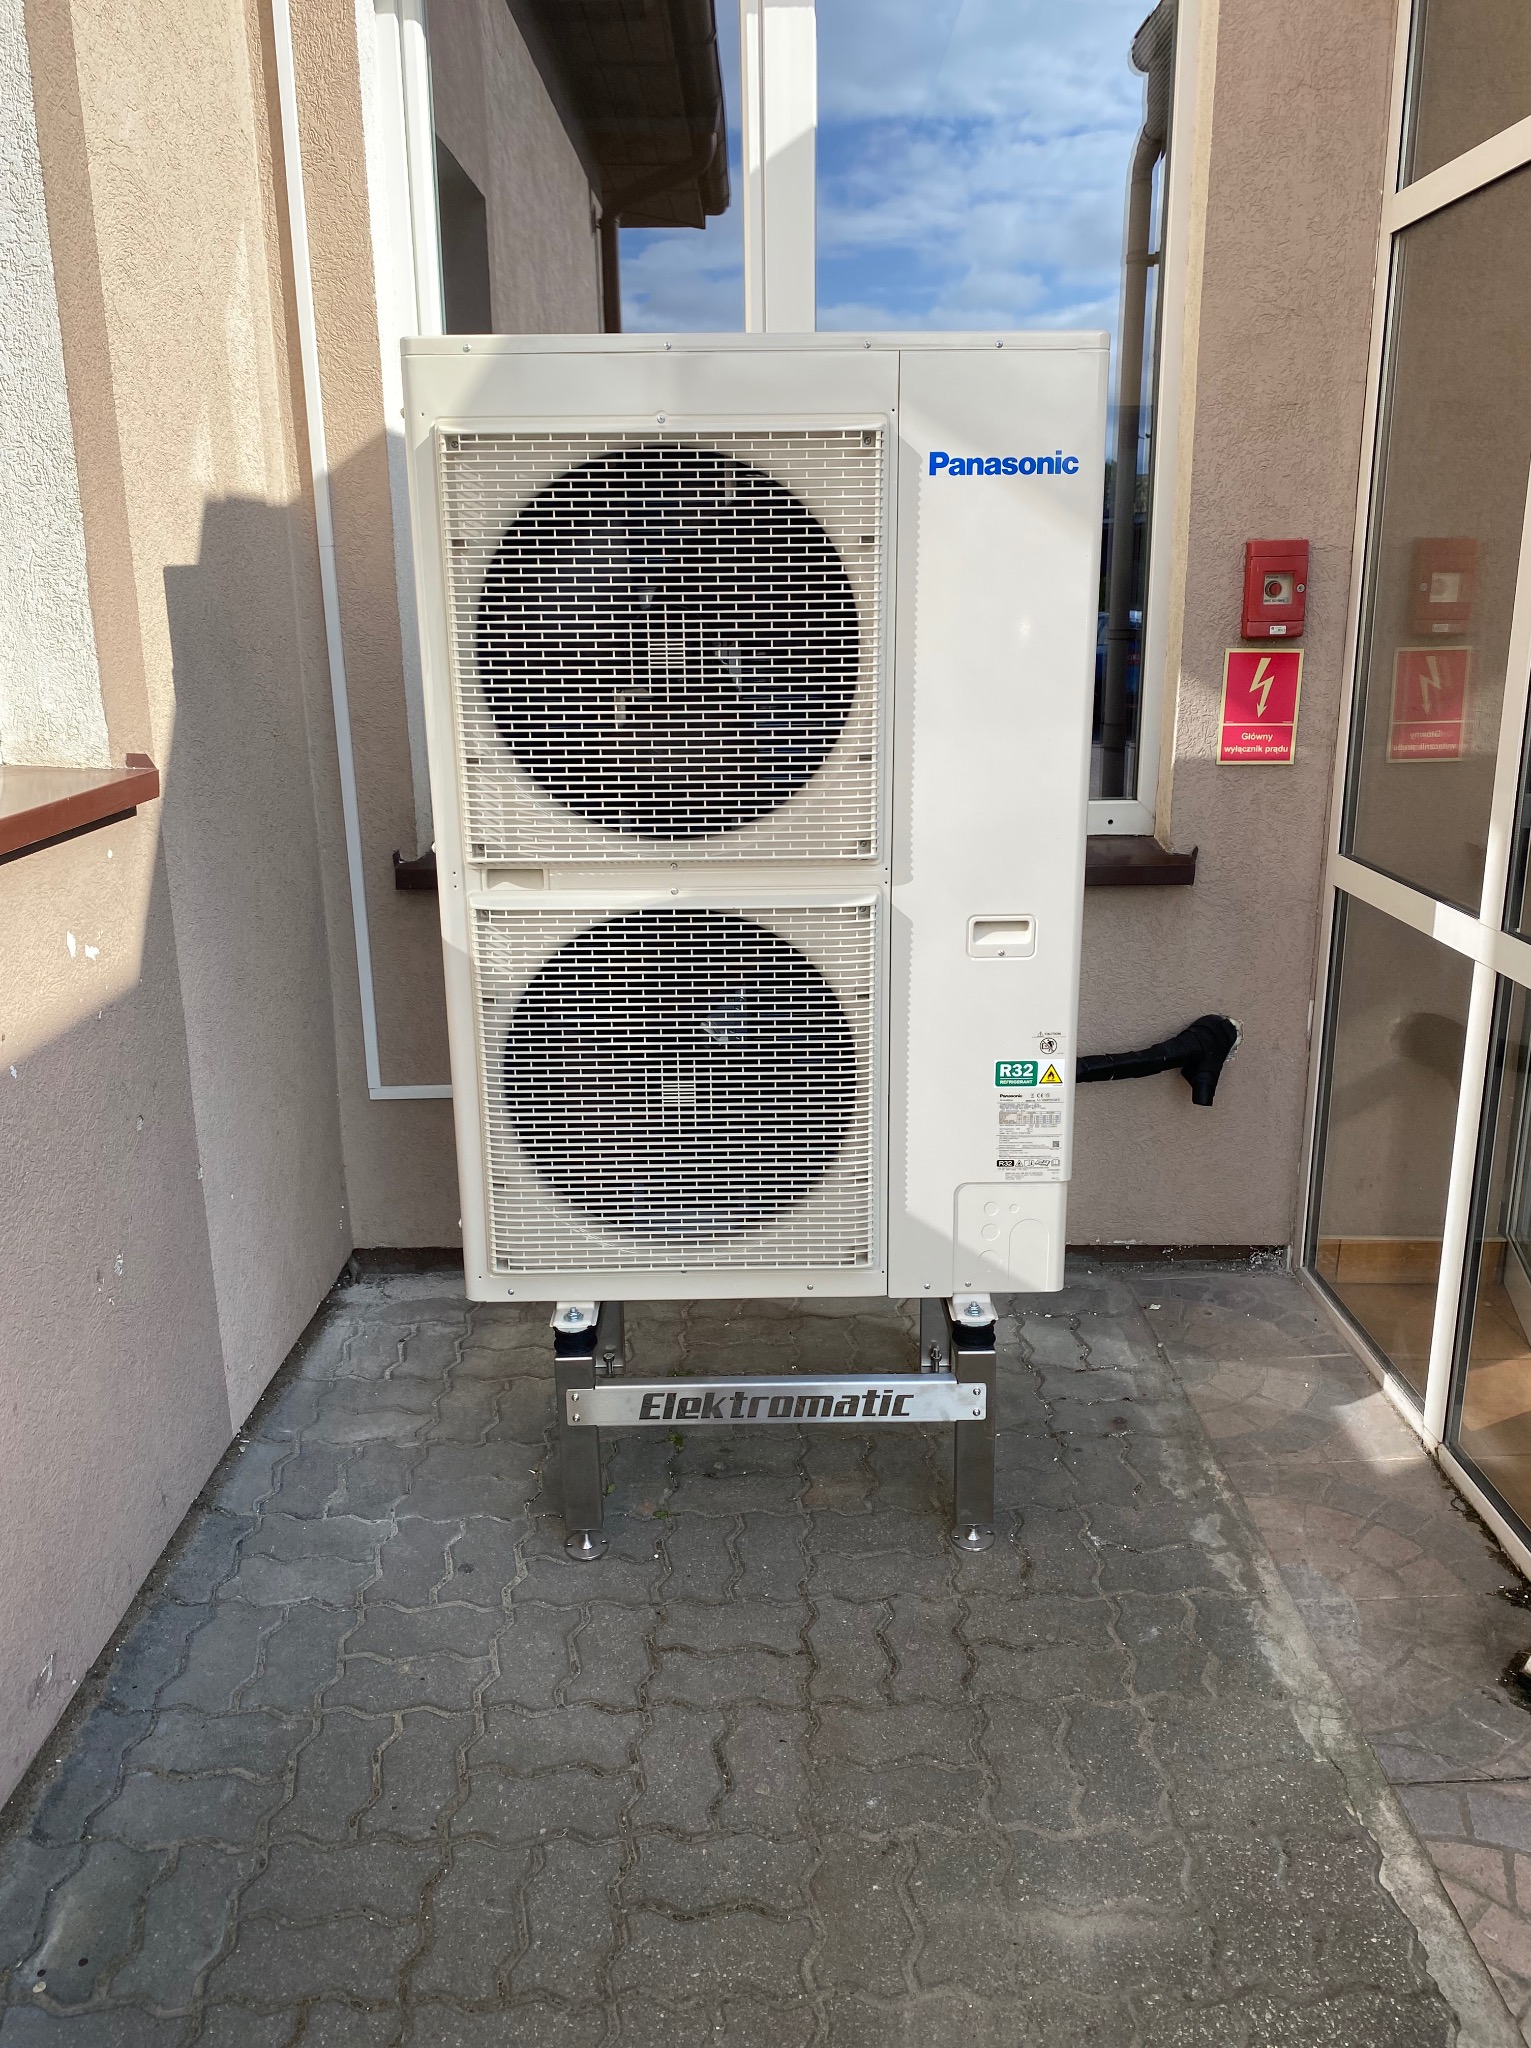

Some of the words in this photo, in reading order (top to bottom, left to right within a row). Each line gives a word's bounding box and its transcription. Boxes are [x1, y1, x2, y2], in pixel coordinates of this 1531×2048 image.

[929, 450, 1079, 476] Panasonic
[1241, 732, 1273, 742] Główny
[1224, 745, 1263, 754] wyłącznik
[1265, 745, 1289, 754] prądu
[999, 1063, 1034, 1077] R32
[638, 1389, 914, 1421] Elektromatic
